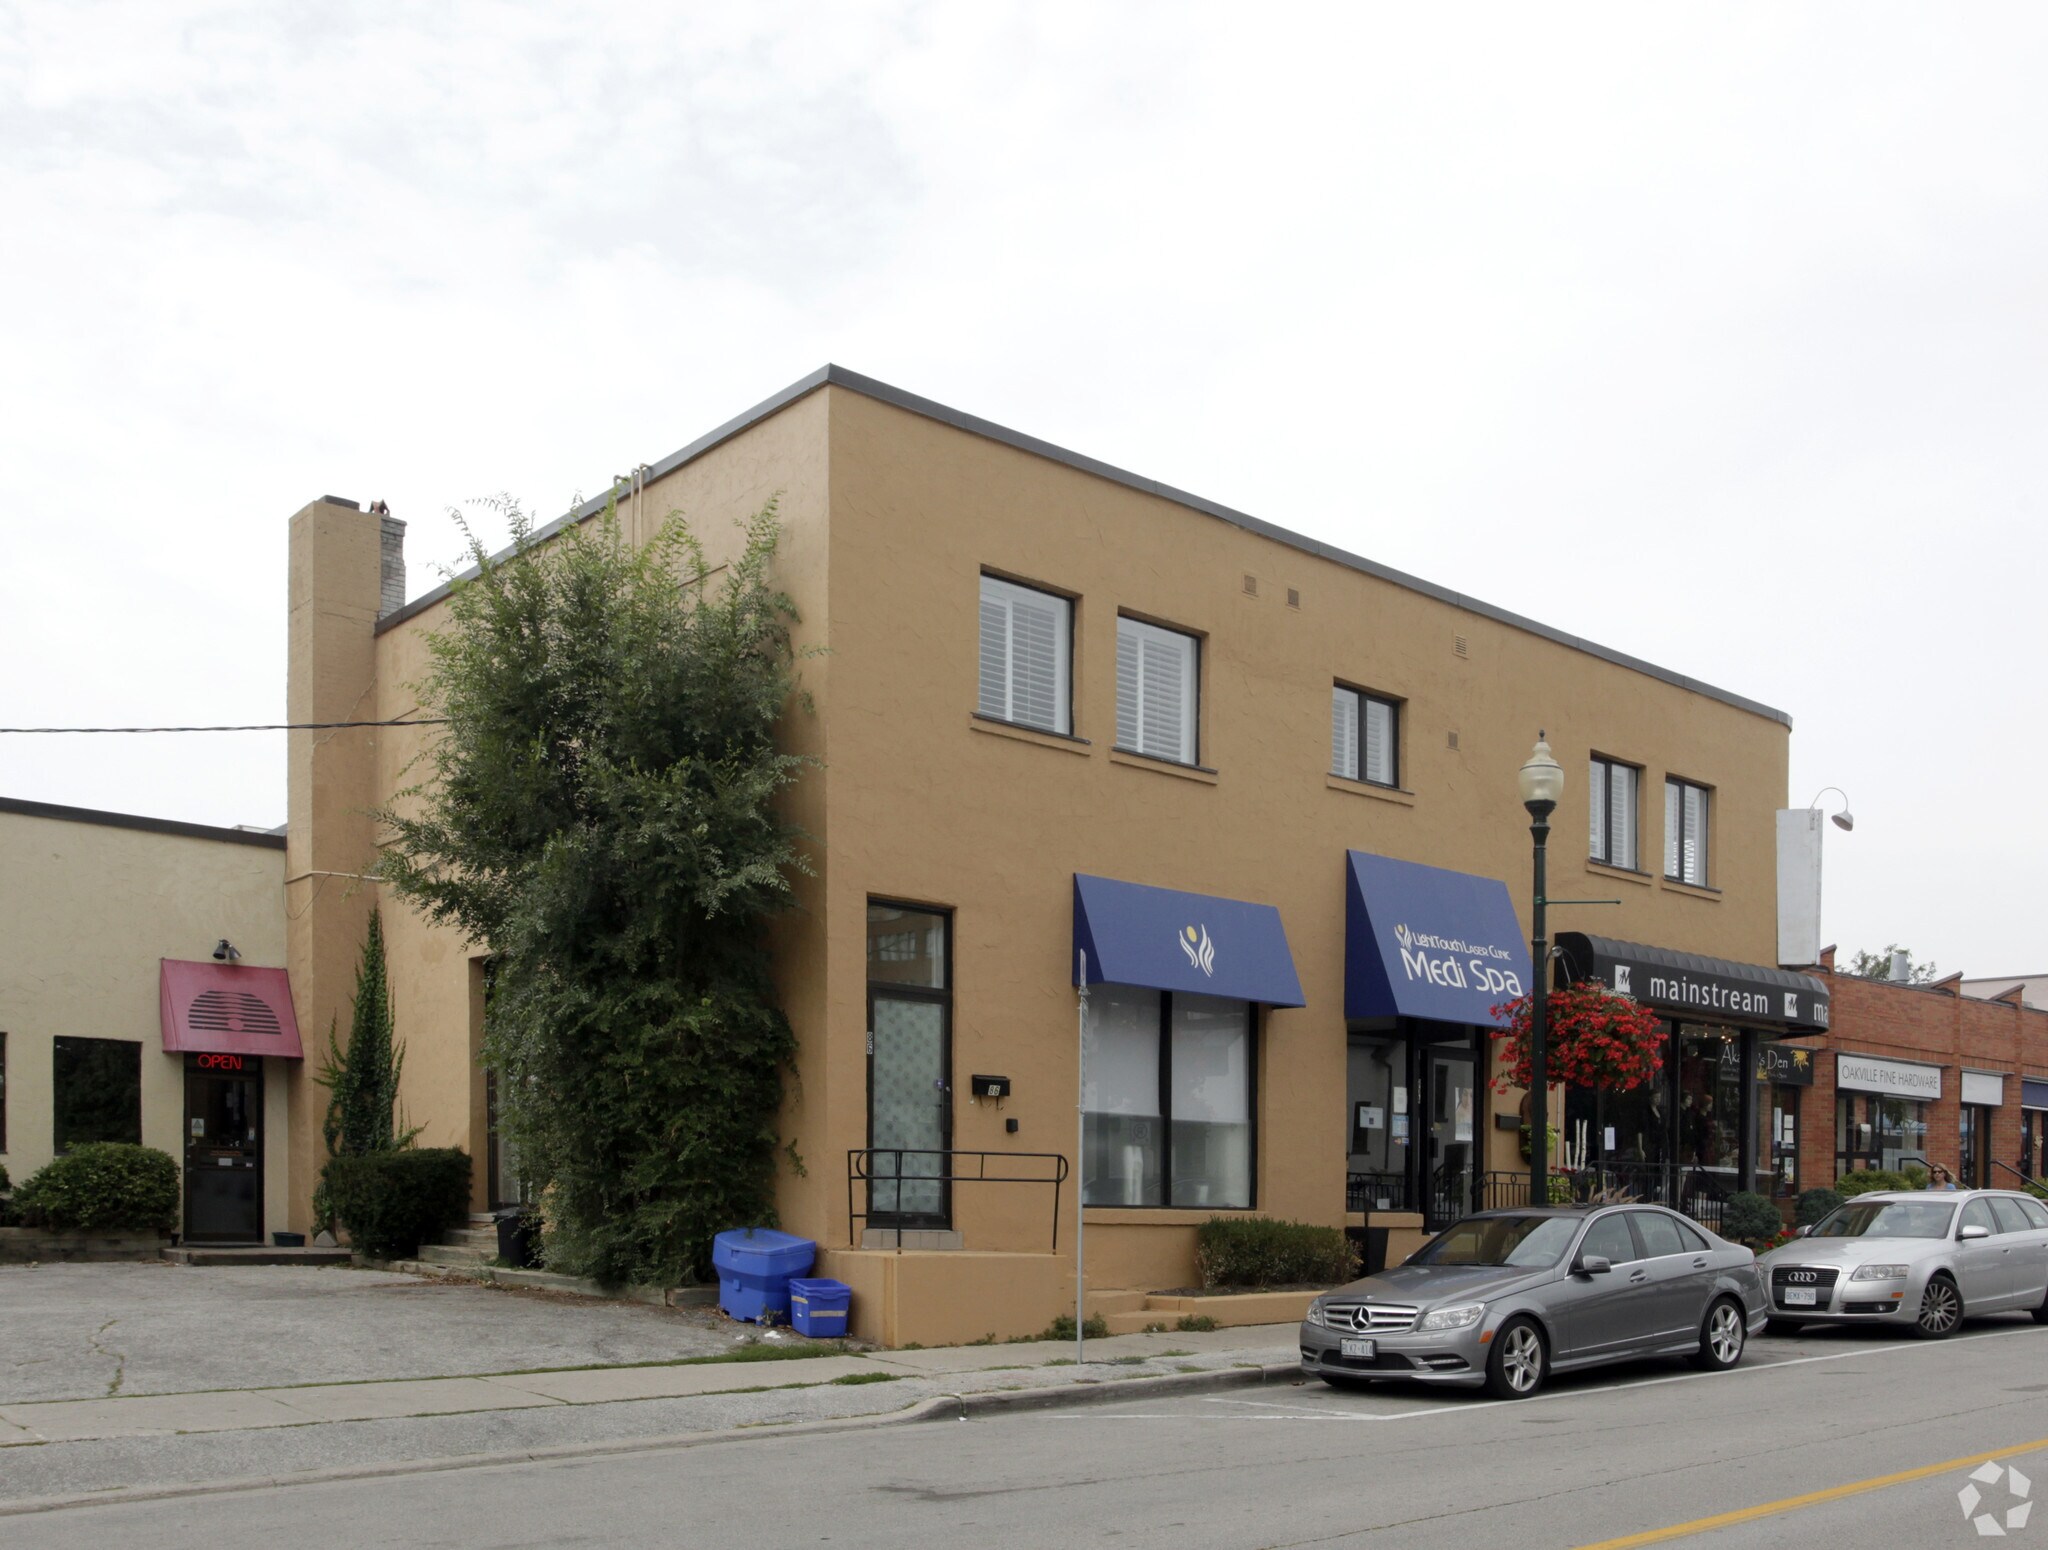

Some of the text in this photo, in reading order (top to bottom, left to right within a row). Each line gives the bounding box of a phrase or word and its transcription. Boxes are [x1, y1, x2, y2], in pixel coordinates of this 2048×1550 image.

[1469, 959, 1523, 996] Spa
[1650, 976, 1768, 1014] mainstream
[198, 1054, 242, 1069] OPEN
[1767, 1050, 1788, 1070] Den
[1842, 1065, 1937, 1089] OAKVILLE FINE HARDWARE
[988, 1085, 1000, 1096] 86
